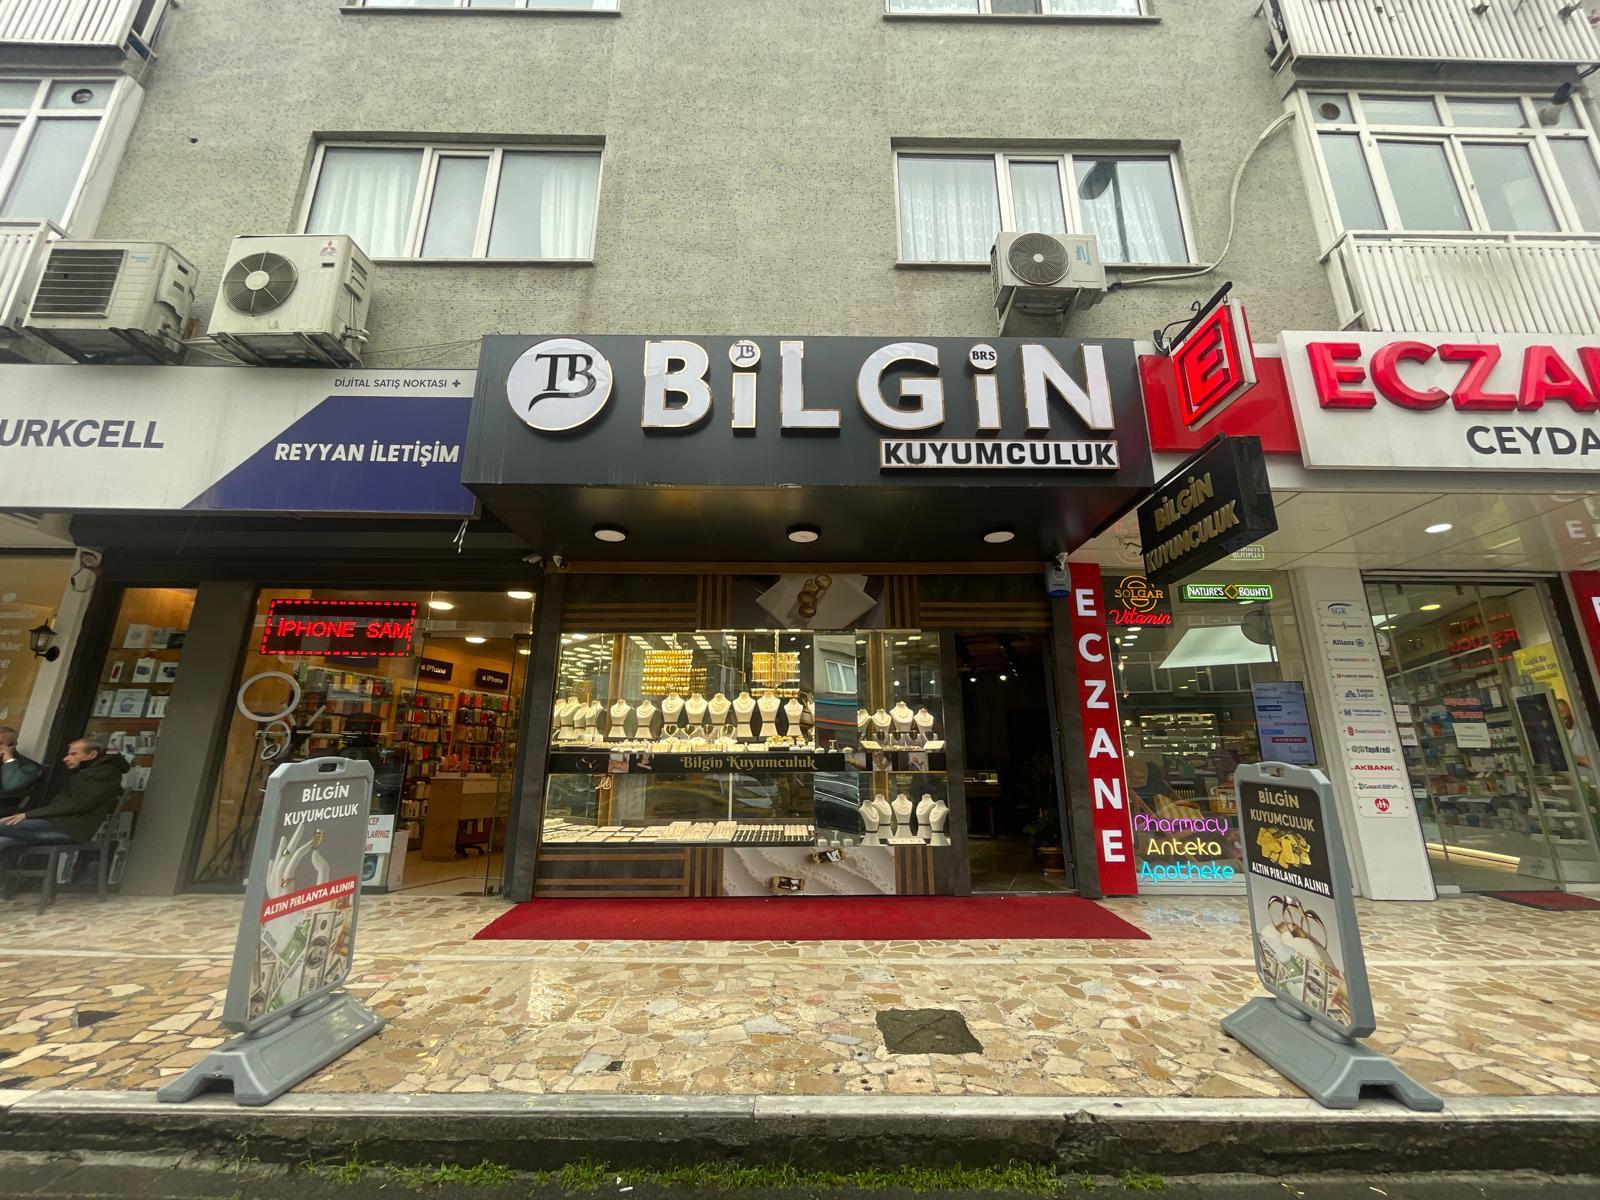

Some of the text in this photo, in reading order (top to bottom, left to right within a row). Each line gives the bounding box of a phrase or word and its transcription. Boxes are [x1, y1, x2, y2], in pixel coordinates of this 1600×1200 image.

[971, 350, 995, 361] BRS
[334, 378, 370, 388] DİJİTAL
[374, 378, 400, 390] SATIŞ
[403, 379, 447, 388] NOKTASI
[275, 440, 460, 467] REYYAN İLETİŞİM
[884, 442, 1117, 466] KUYUMCULUK
[1153, 472, 1215, 532] BİLGİN
[1145, 499, 1240, 574] KUYUMCULUK
[1114, 588, 1164, 599] SOLGAR
[1238, 585, 1269, 597] BOUNTY
[1109, 606, 1172, 625] Vitamin
[1075, 588, 1126, 863] ECZANE
[680, 755, 819, 772] Bilgin Kuyumculuk
[301, 781, 350, 803] BİLGİN
[1258, 787, 1300, 809] BİLGİN
[284, 803, 359, 827] KUYUMCULUK
[1133, 814, 1229, 836] Pharmacy
[1250, 808, 1315, 832] KUYUMCULUK
[1147, 838, 1222, 856] Anteka
[1140, 861, 1235, 884] Apotheke
[1252, 861, 1331, 896] ALTIN PIRLANTA ALINIR
[263, 880, 355, 917] ALTIN PIRLANTA ALINIR
